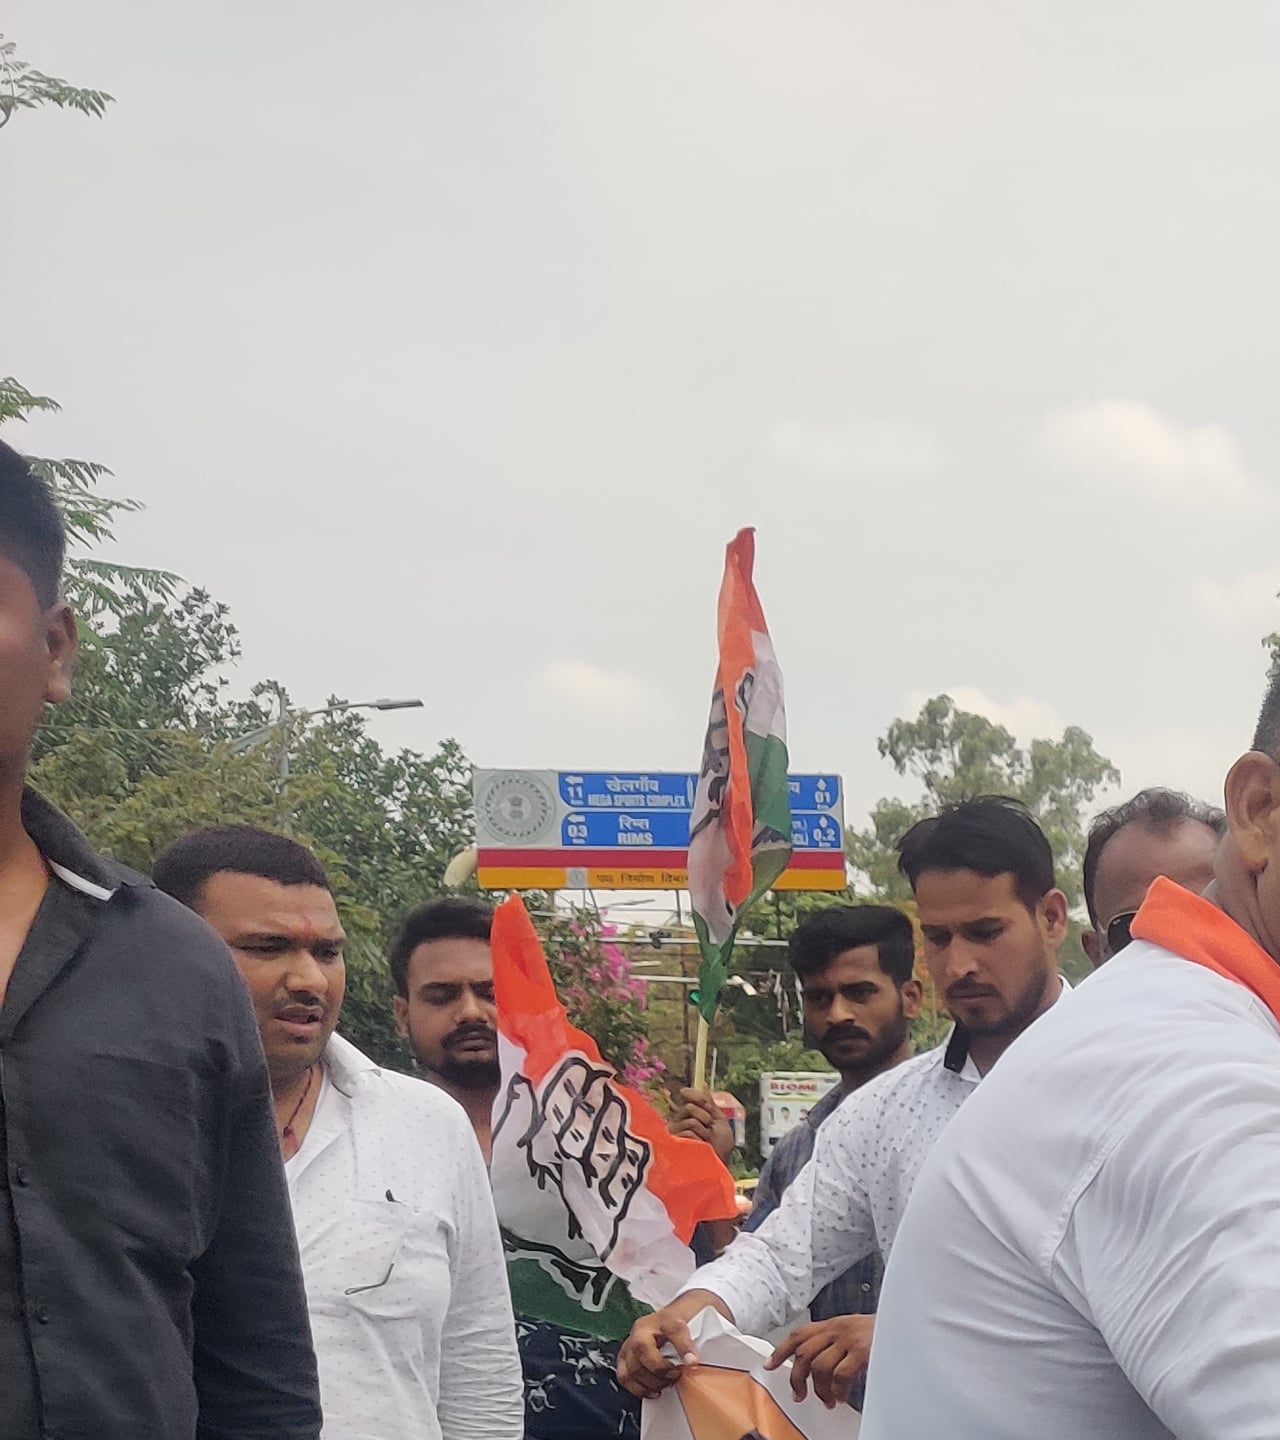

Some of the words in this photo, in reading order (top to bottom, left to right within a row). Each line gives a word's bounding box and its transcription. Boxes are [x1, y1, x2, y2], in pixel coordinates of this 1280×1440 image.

[567, 786, 584, 799] 11
[567, 824, 588, 838] 03
[617, 832, 653, 845] RIMS
